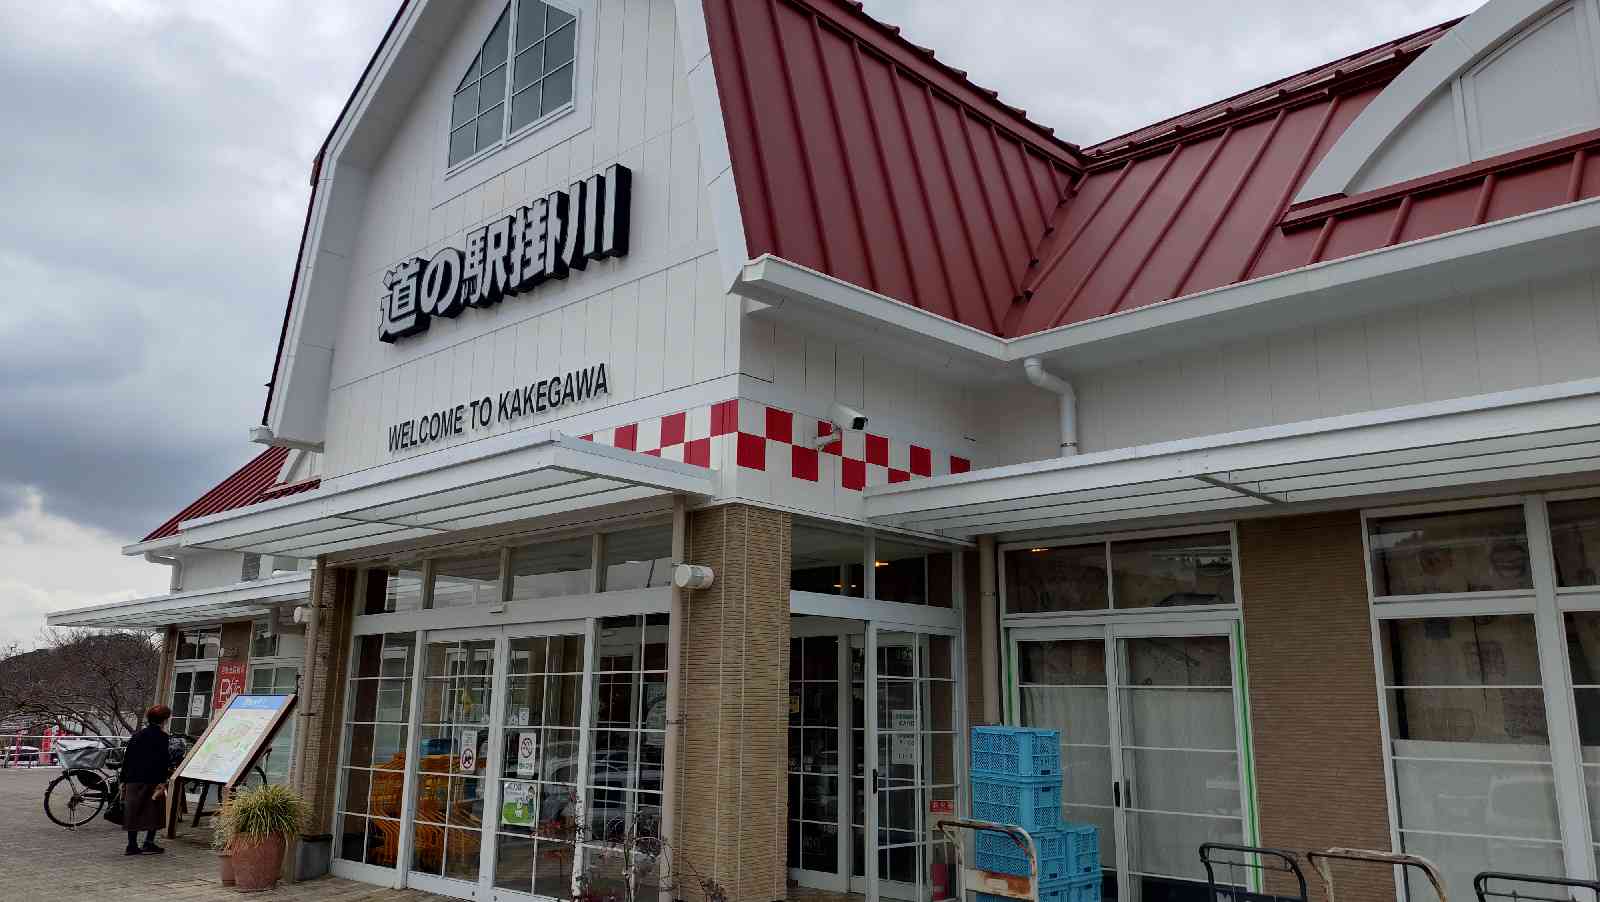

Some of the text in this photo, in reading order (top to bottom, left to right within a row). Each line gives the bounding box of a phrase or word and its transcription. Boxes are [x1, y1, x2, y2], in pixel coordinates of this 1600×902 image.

[378, 163, 632, 343] 道の駅掛川
[388, 362, 609, 452] WELCOME TO KAKEGAWA
